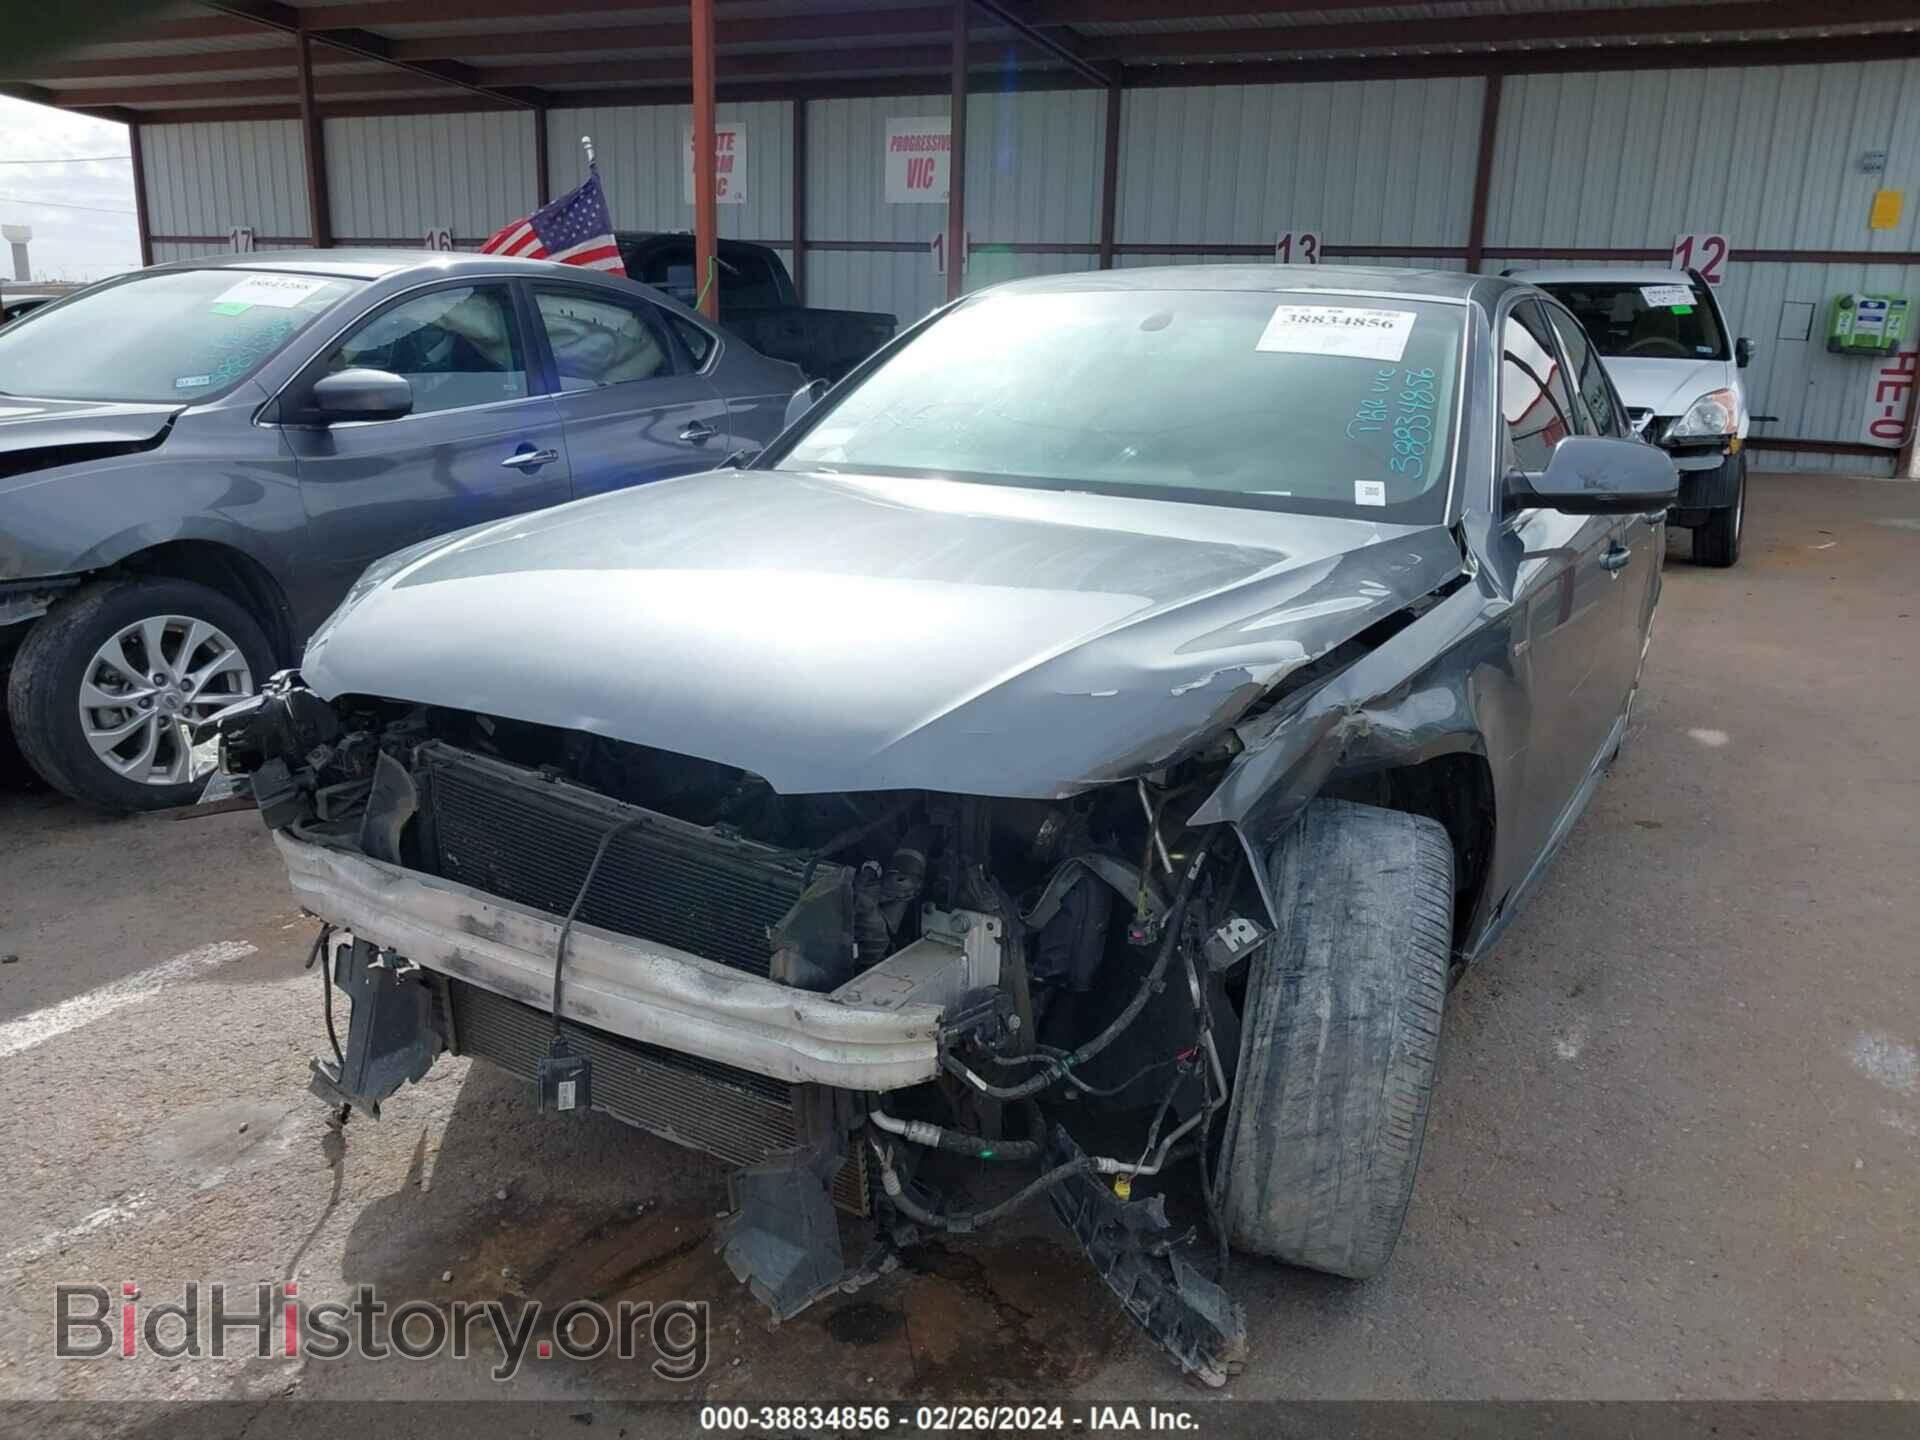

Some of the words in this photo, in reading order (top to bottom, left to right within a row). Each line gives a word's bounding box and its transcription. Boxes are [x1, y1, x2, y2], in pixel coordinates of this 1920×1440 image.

[906, 157, 935, 190] VIC
[231, 229, 251, 254] 17
[426, 230, 450, 252] 16
[1277, 233, 1317, 265] 13
[1675, 235, 1726, 284] 12
[1288, 313, 1394, 329] 38834856
[1389, 366, 1436, 480] 38834856
